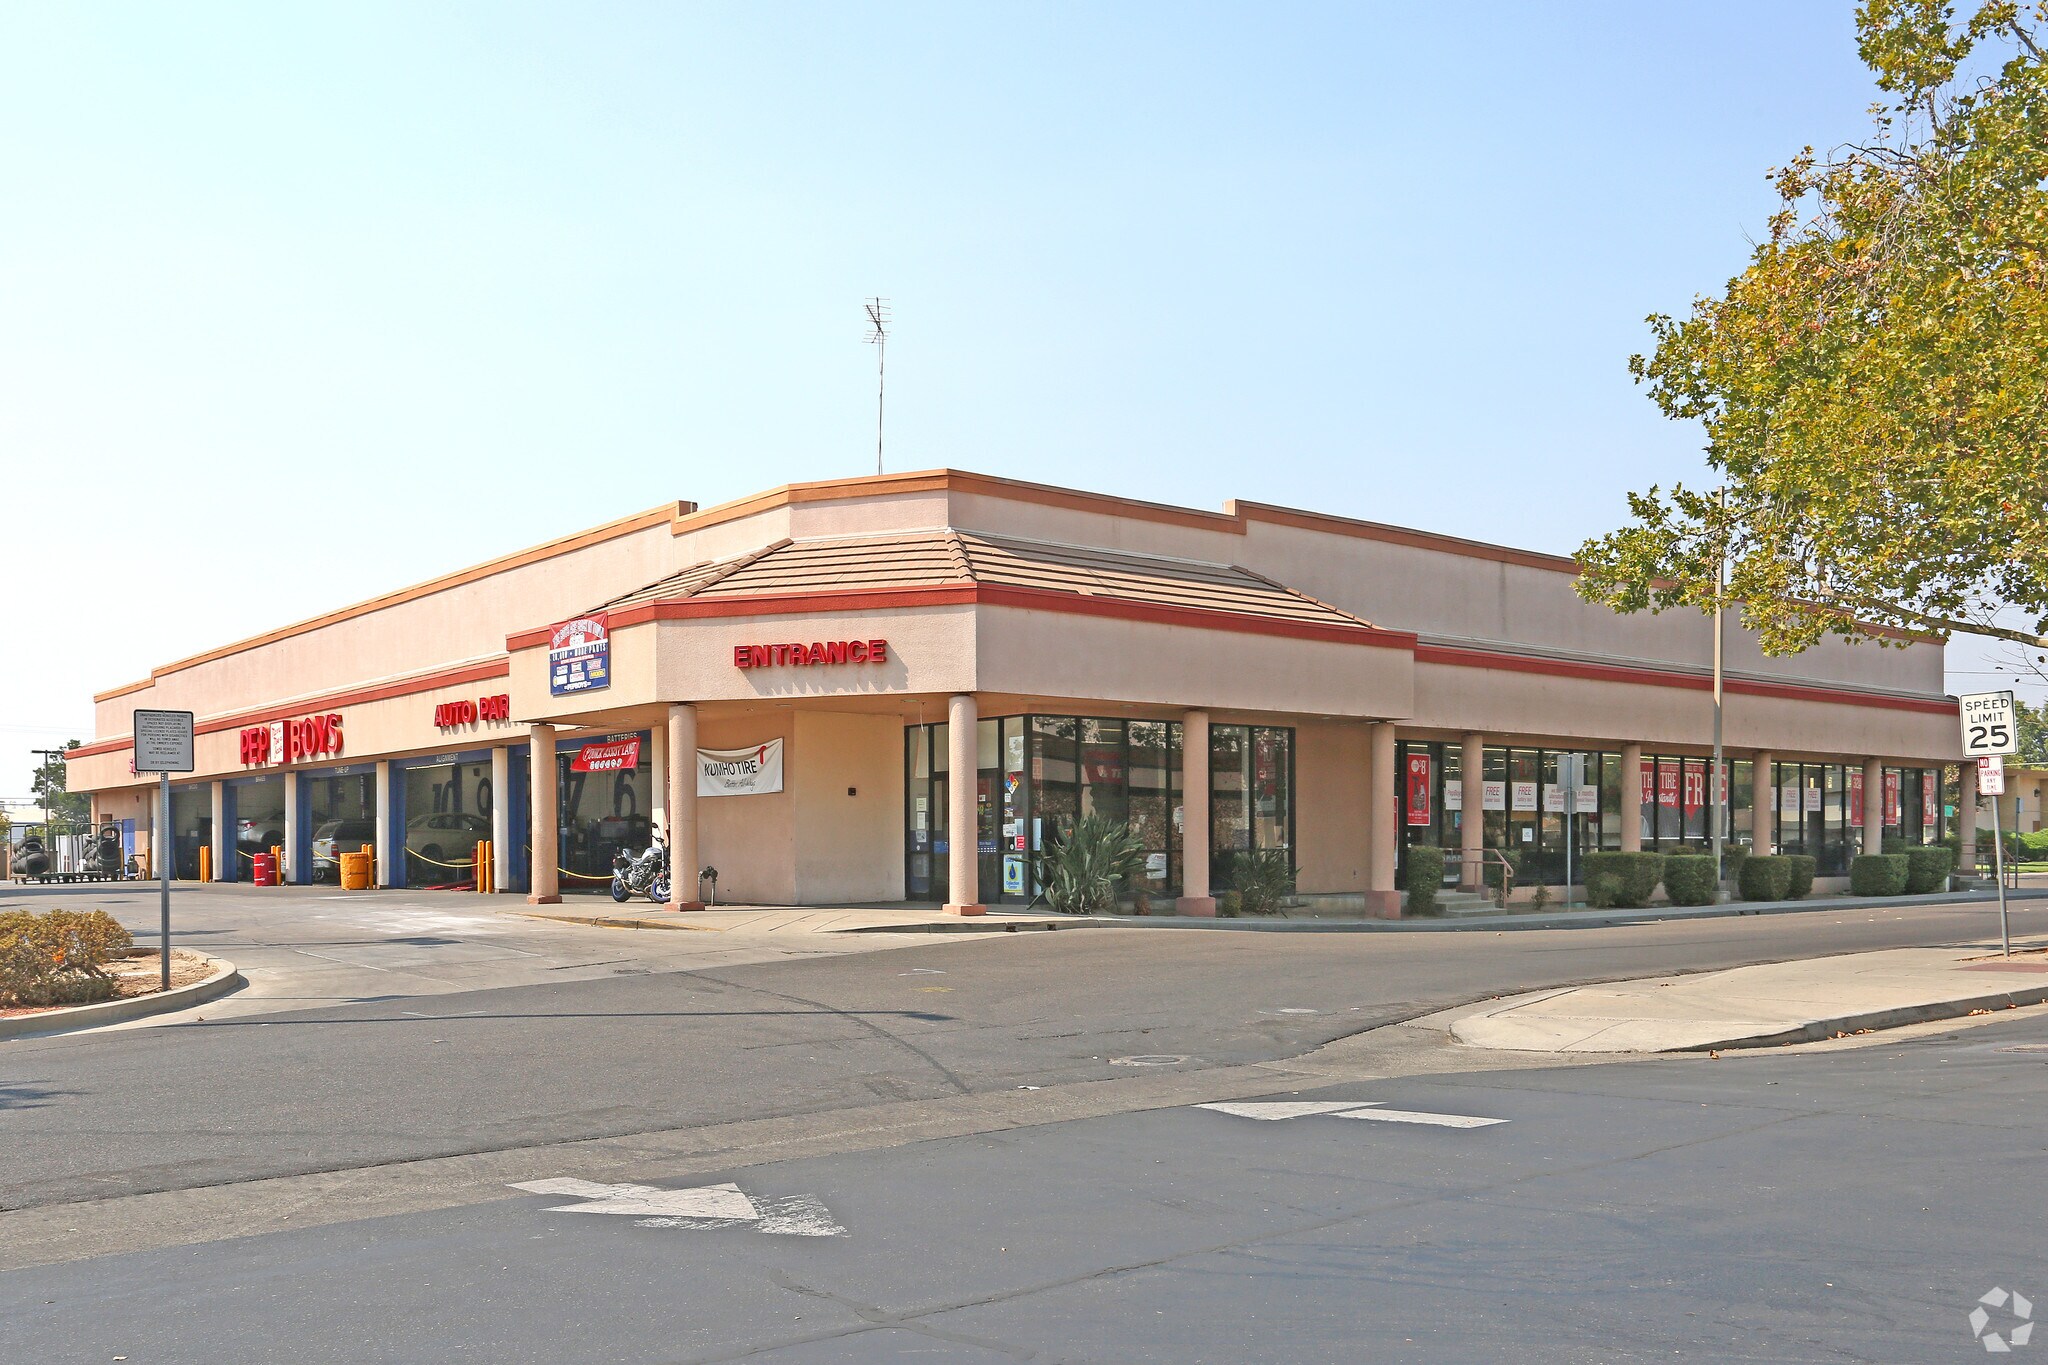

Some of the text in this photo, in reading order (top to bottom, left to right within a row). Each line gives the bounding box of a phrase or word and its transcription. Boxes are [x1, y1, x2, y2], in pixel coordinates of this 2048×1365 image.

[589, 643, 606, 654] PARTS
[734, 640, 887, 668] ENTRANCE
[1966, 698, 2009, 712] SPEED
[434, 700, 477, 728] AUTO
[1970, 712, 2004, 724] LIMIT
[240, 714, 344, 764] PEP BOYS
[1969, 724, 2010, 748] 25
[436, 753, 458, 762] ALIGNMENT
[582, 746, 604, 762] QUICK
[621, 742, 638, 756] LANE
[704, 760, 758, 776] KUMHO TIRE
[1980, 758, 1988, 768] NO
[1660, 772, 1677, 789] TIRE
[614, 768, 636, 818] 6
[1486, 786, 1500, 796] FREE
[1518, 786, 1532, 796] FREE
